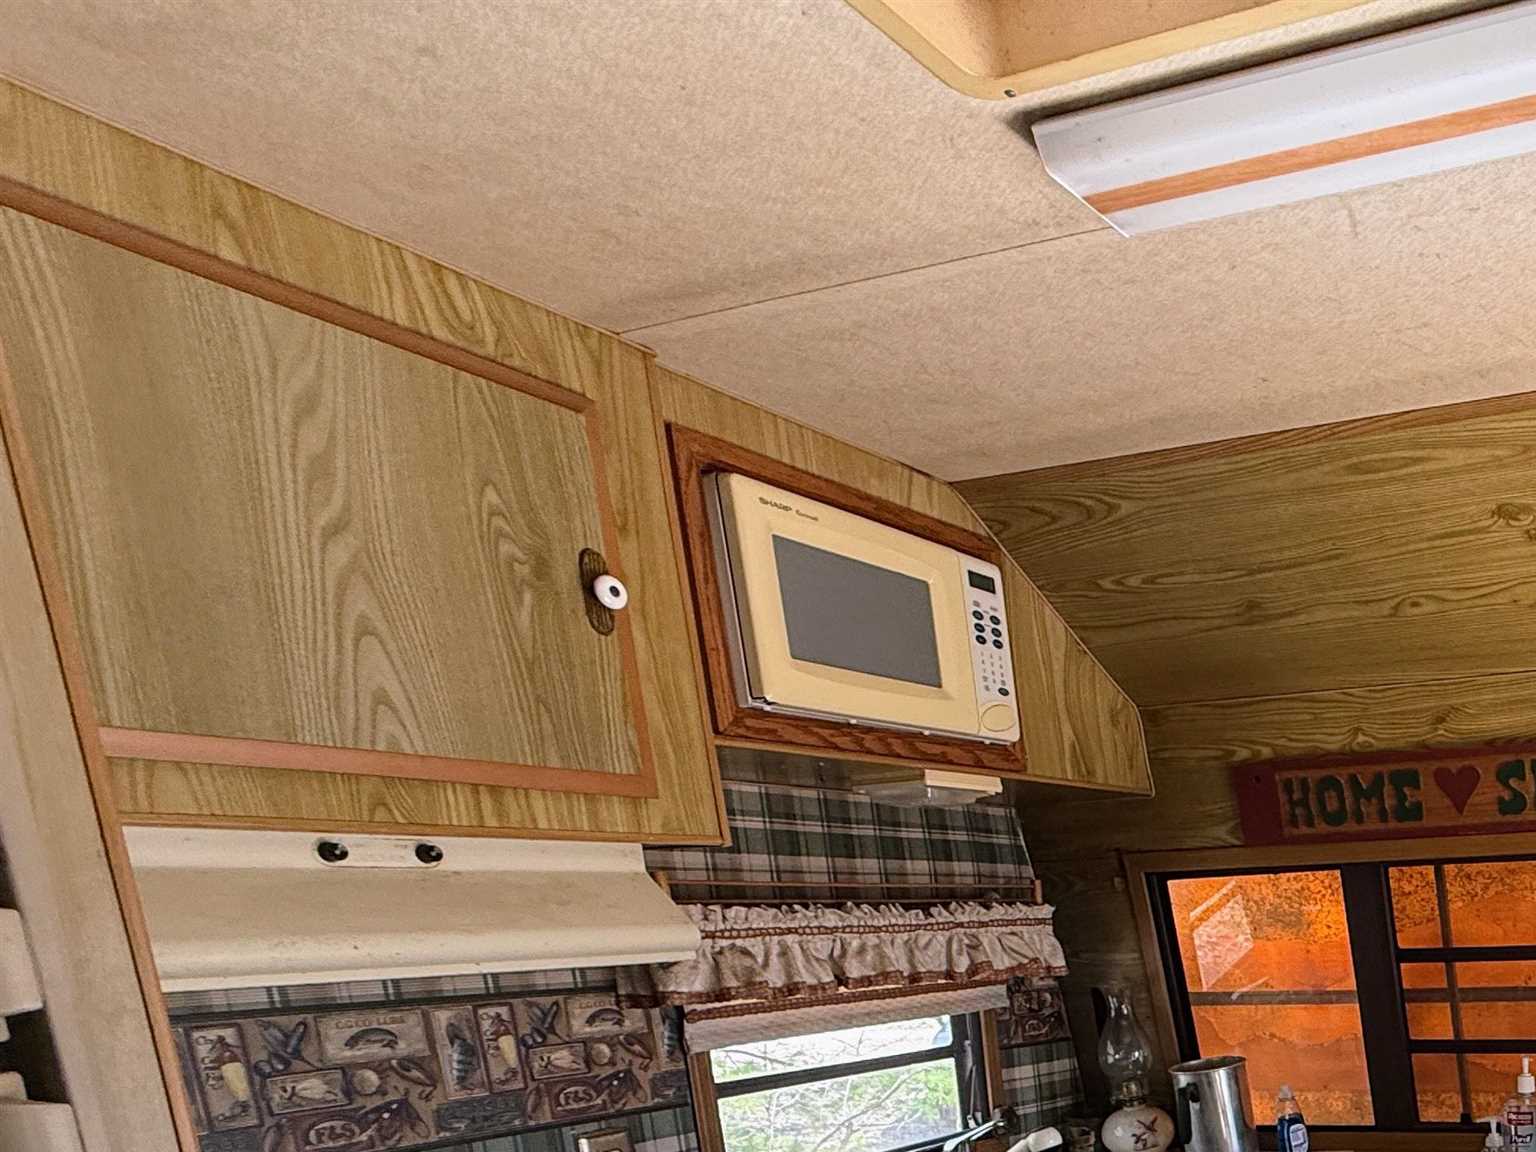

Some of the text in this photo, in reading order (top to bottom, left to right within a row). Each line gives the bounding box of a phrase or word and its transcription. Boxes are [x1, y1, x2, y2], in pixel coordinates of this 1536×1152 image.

[1281, 767, 1424, 829] HOME
[563, 1087, 595, 1107] F&S
[314, 1122, 356, 1146] F&S
